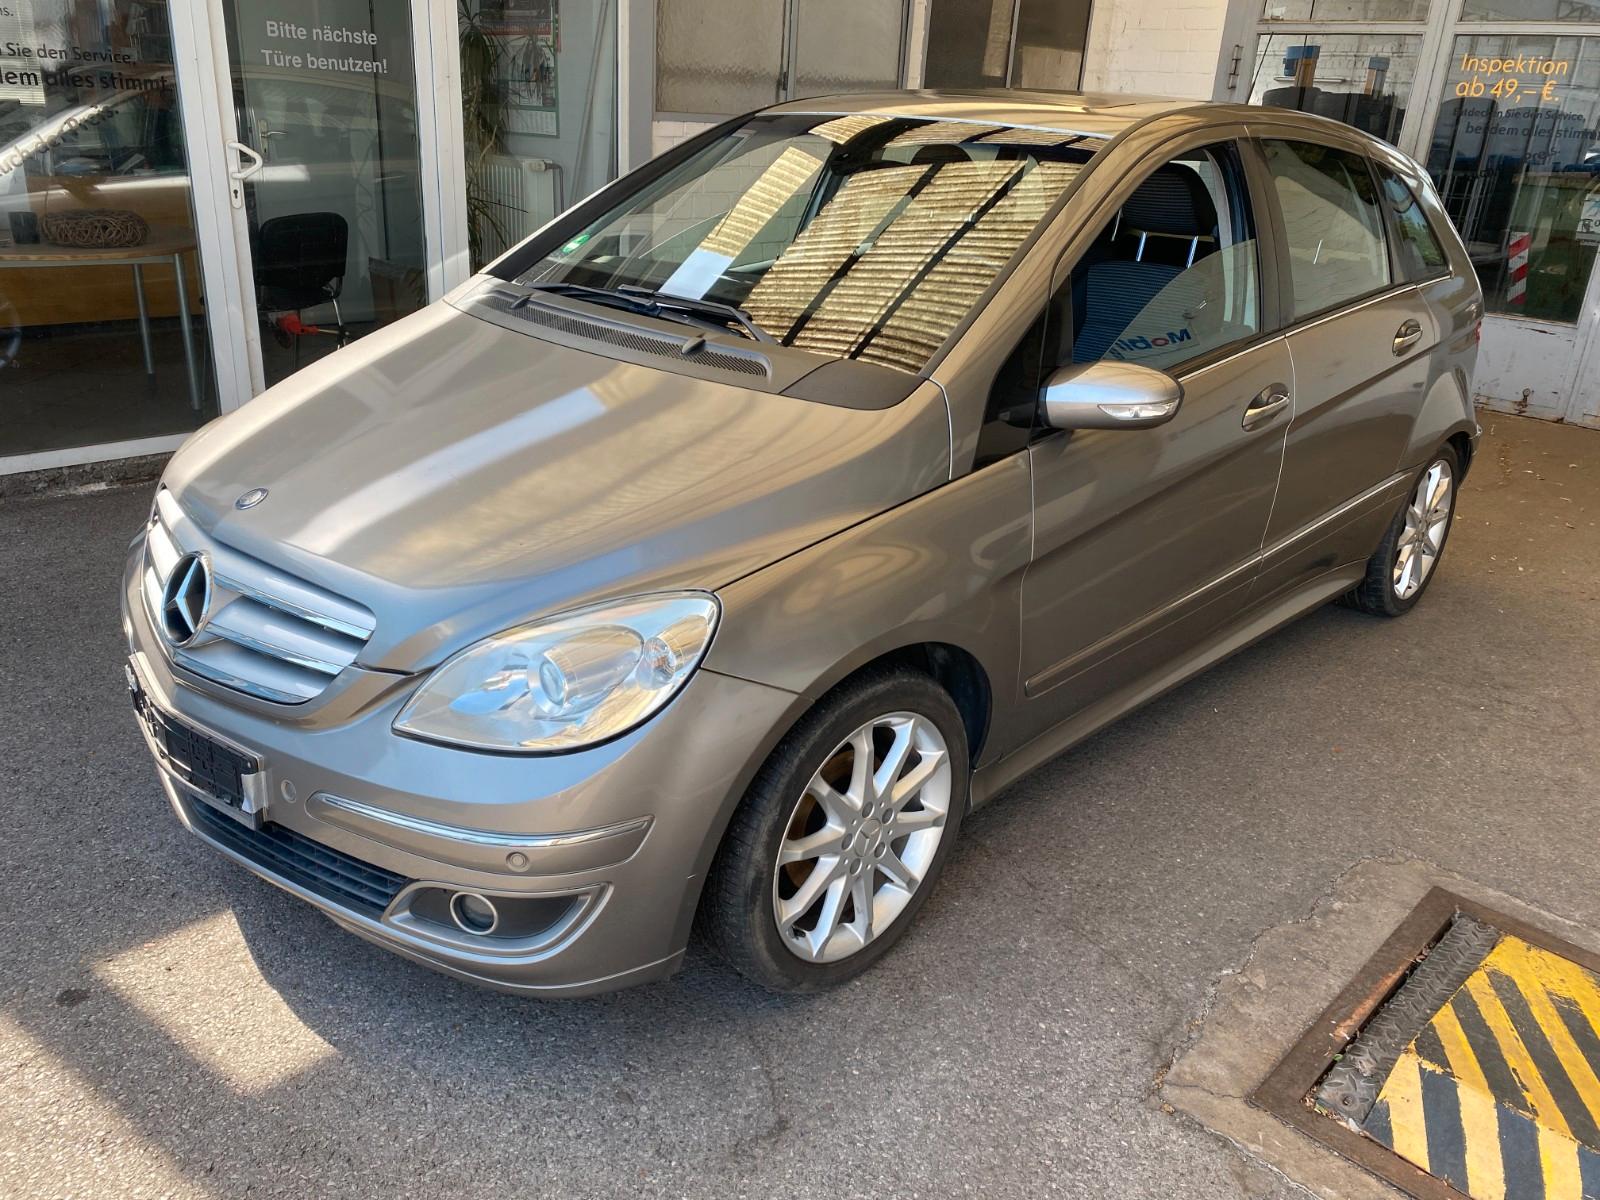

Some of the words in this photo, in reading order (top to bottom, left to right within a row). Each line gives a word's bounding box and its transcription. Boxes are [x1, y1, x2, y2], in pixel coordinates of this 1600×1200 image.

[266, 20, 307, 40] Bitte
[312, 25, 378, 46] nächste
[7, 42, 32, 58] Sie
[37, 44, 68, 61] den
[261, 49, 302, 68] Türe
[307, 53, 388, 74] benutzen!
[1460, 53, 1569, 76] Inspektion
[45, 69, 95, 89] alles
[1456, 75, 1485, 97] ab
[1489, 123, 1519, 136] dem
[1522, 125, 1553, 138] ales
